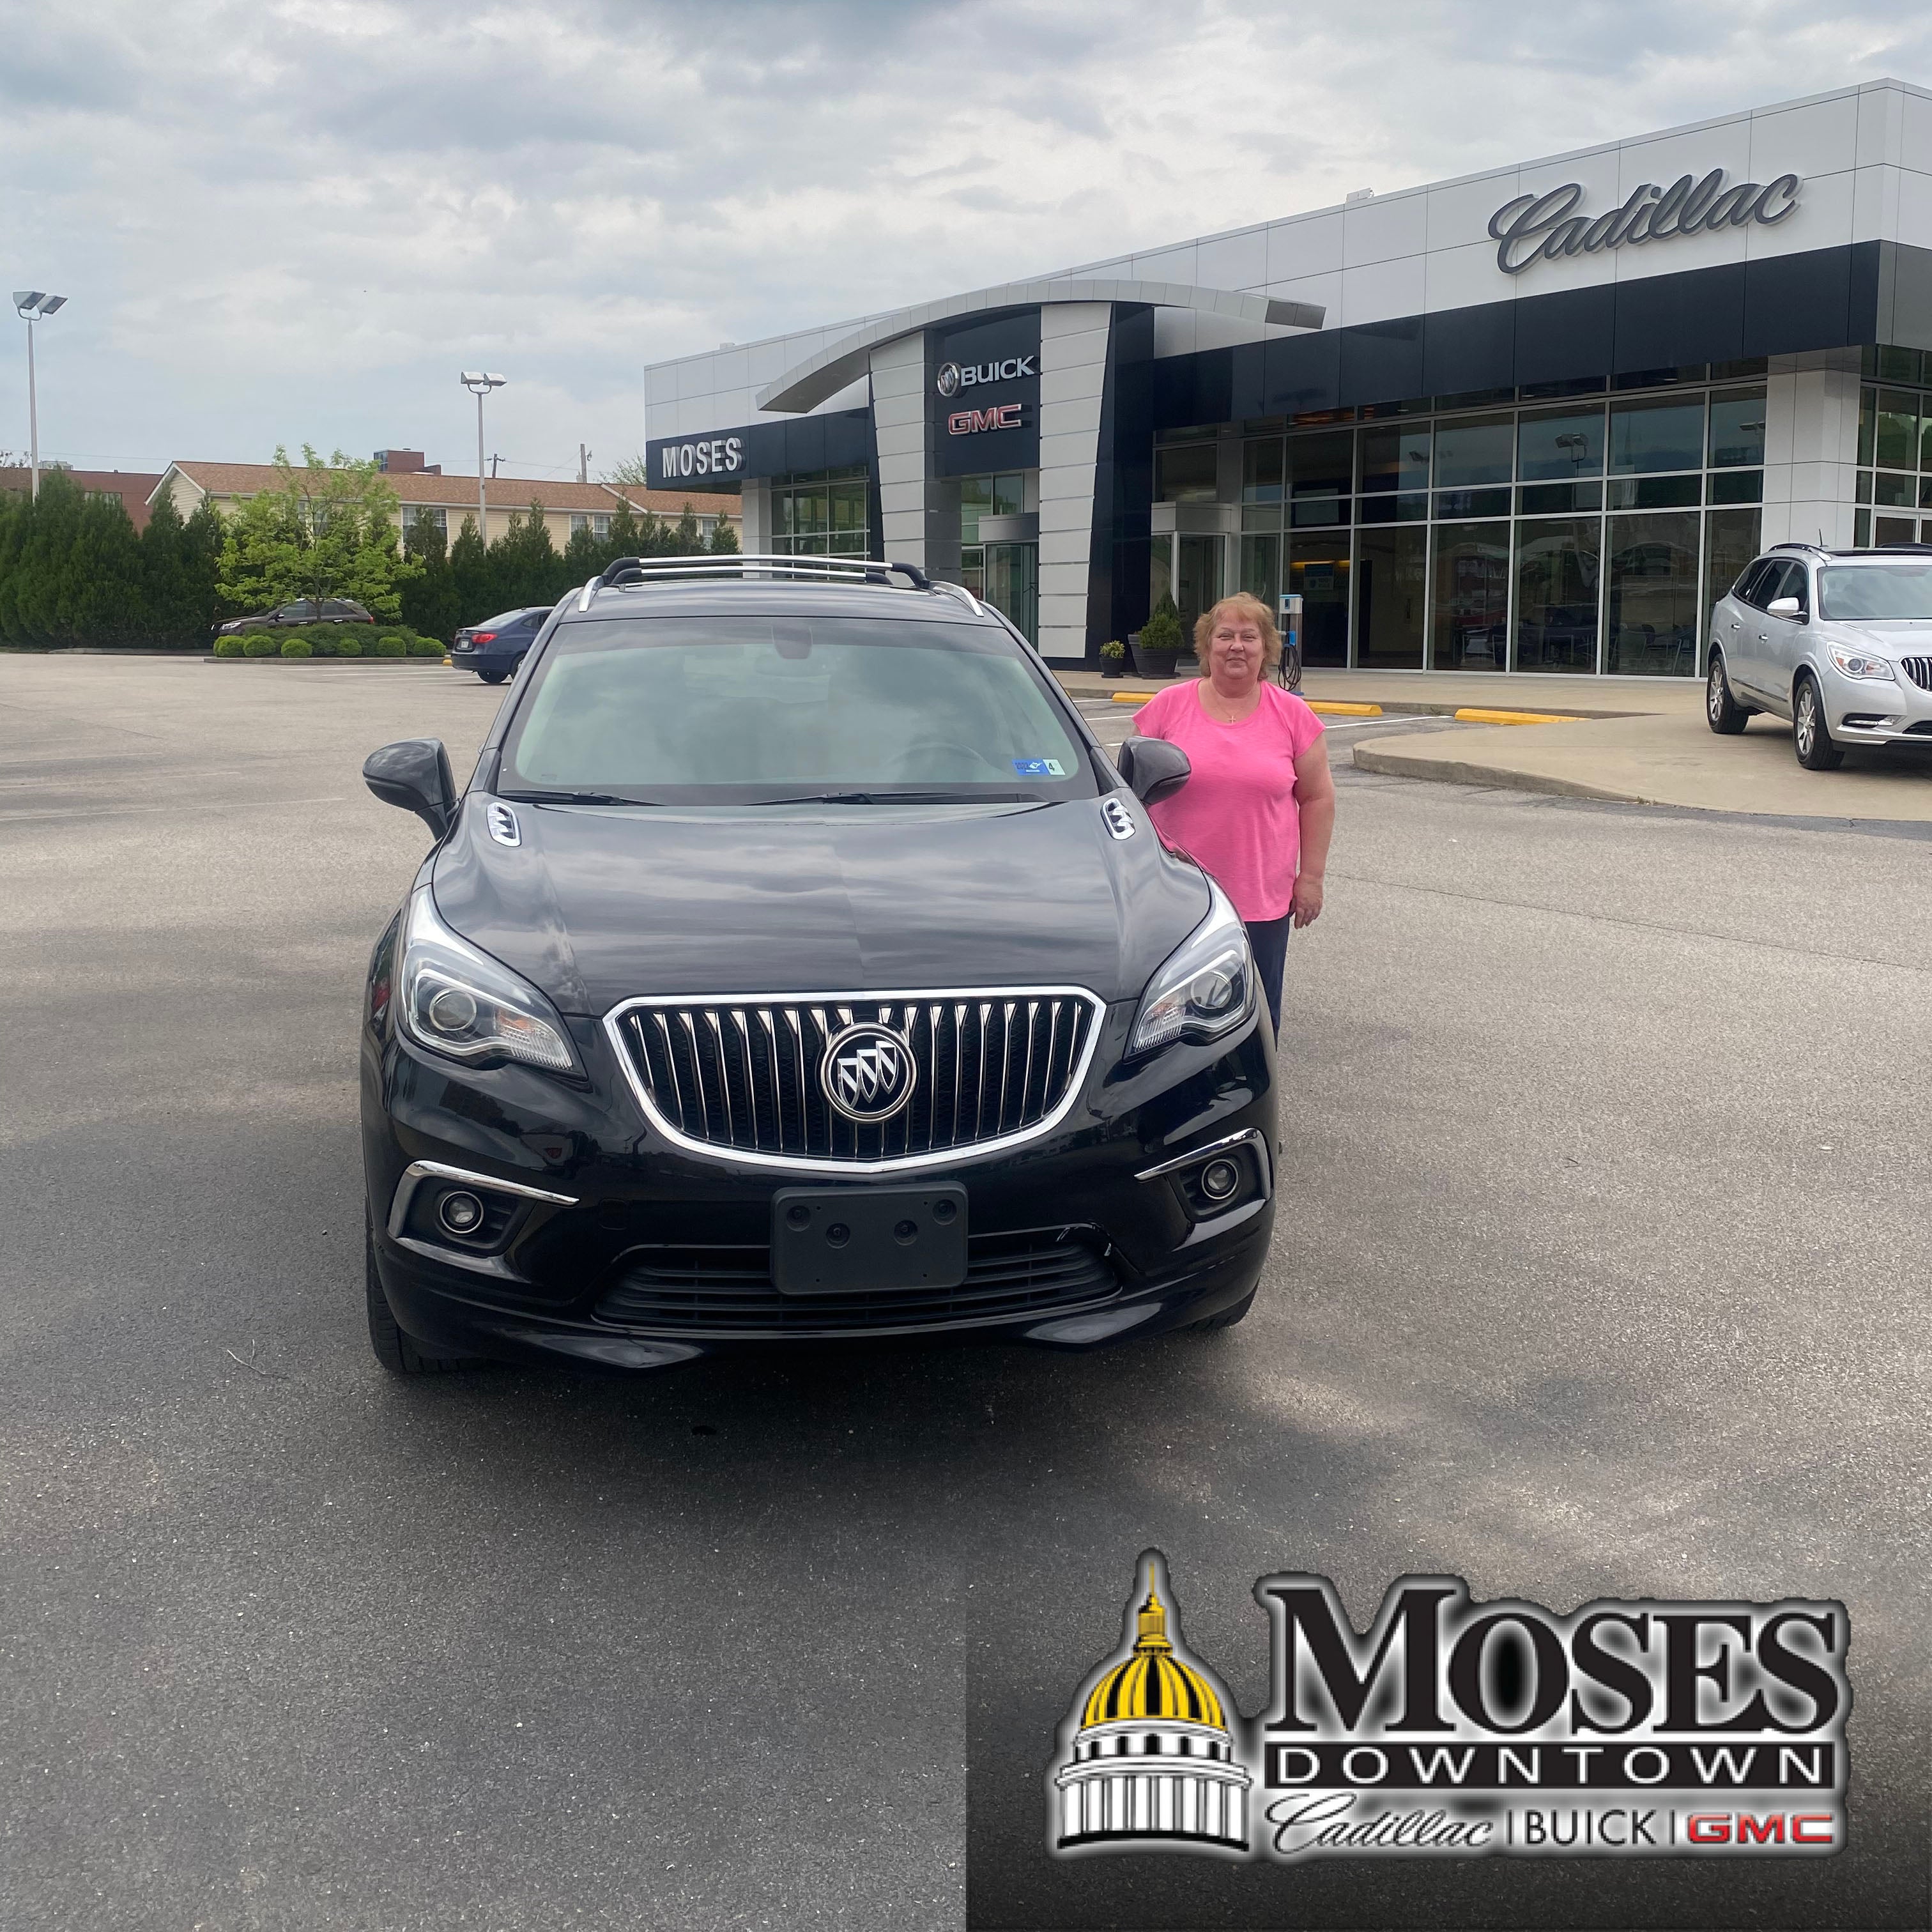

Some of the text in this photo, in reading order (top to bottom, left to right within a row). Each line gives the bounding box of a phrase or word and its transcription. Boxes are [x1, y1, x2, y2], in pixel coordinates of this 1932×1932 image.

[1488, 168, 1802, 275] Cadillac
[960, 355, 1035, 387] BUICK
[948, 403, 1022, 435] GMC
[662, 437, 742, 479] MOSES
